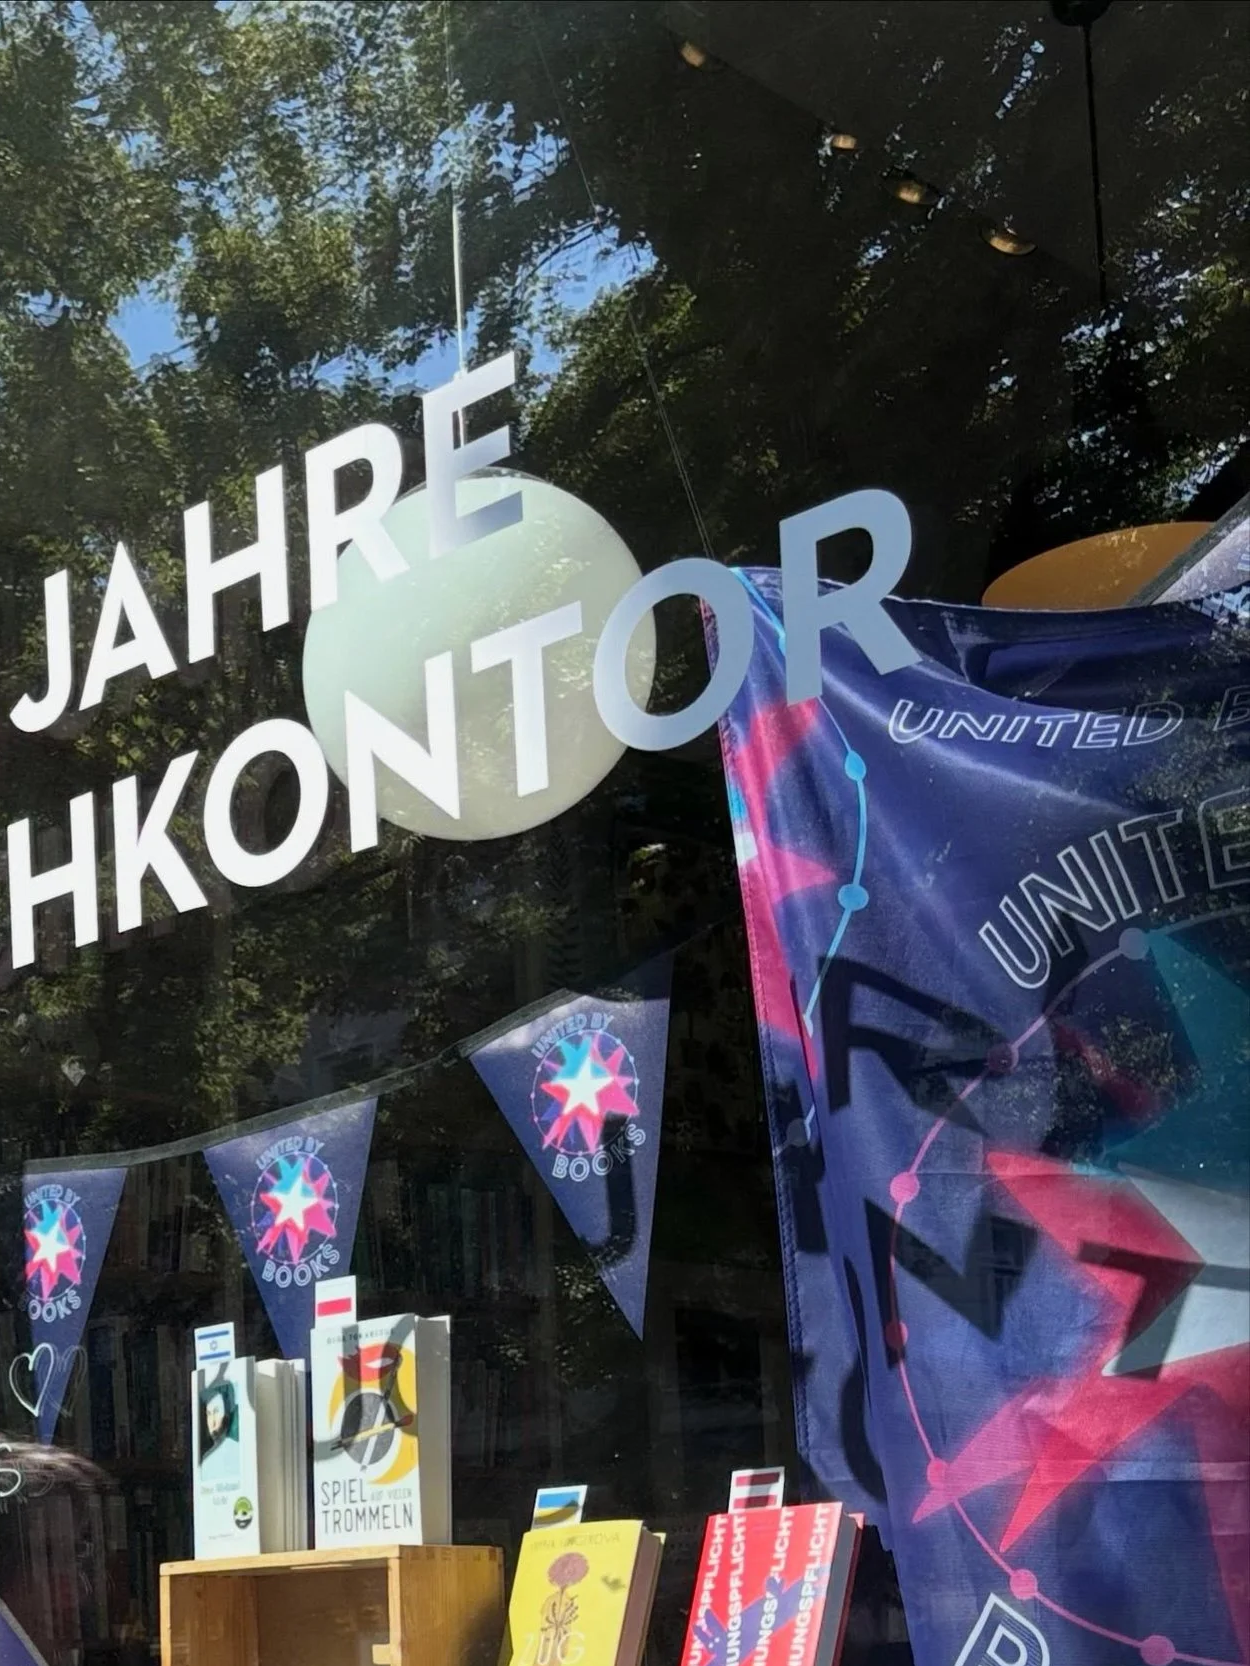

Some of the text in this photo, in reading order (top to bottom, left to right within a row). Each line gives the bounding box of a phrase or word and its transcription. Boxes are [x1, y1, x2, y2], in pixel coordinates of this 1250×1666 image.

[8, 351, 524, 734] JAHRE
[888, 698, 1184, 750] UNITED
[551, 1123, 647, 1182] BOOKS
[261, 1243, 341, 1289] BOOKS
[24, 1289, 82, 1323] OOKS
[320, 1478, 368, 1506] SPIEL
[322, 1502, 414, 1534] TROMMELN
